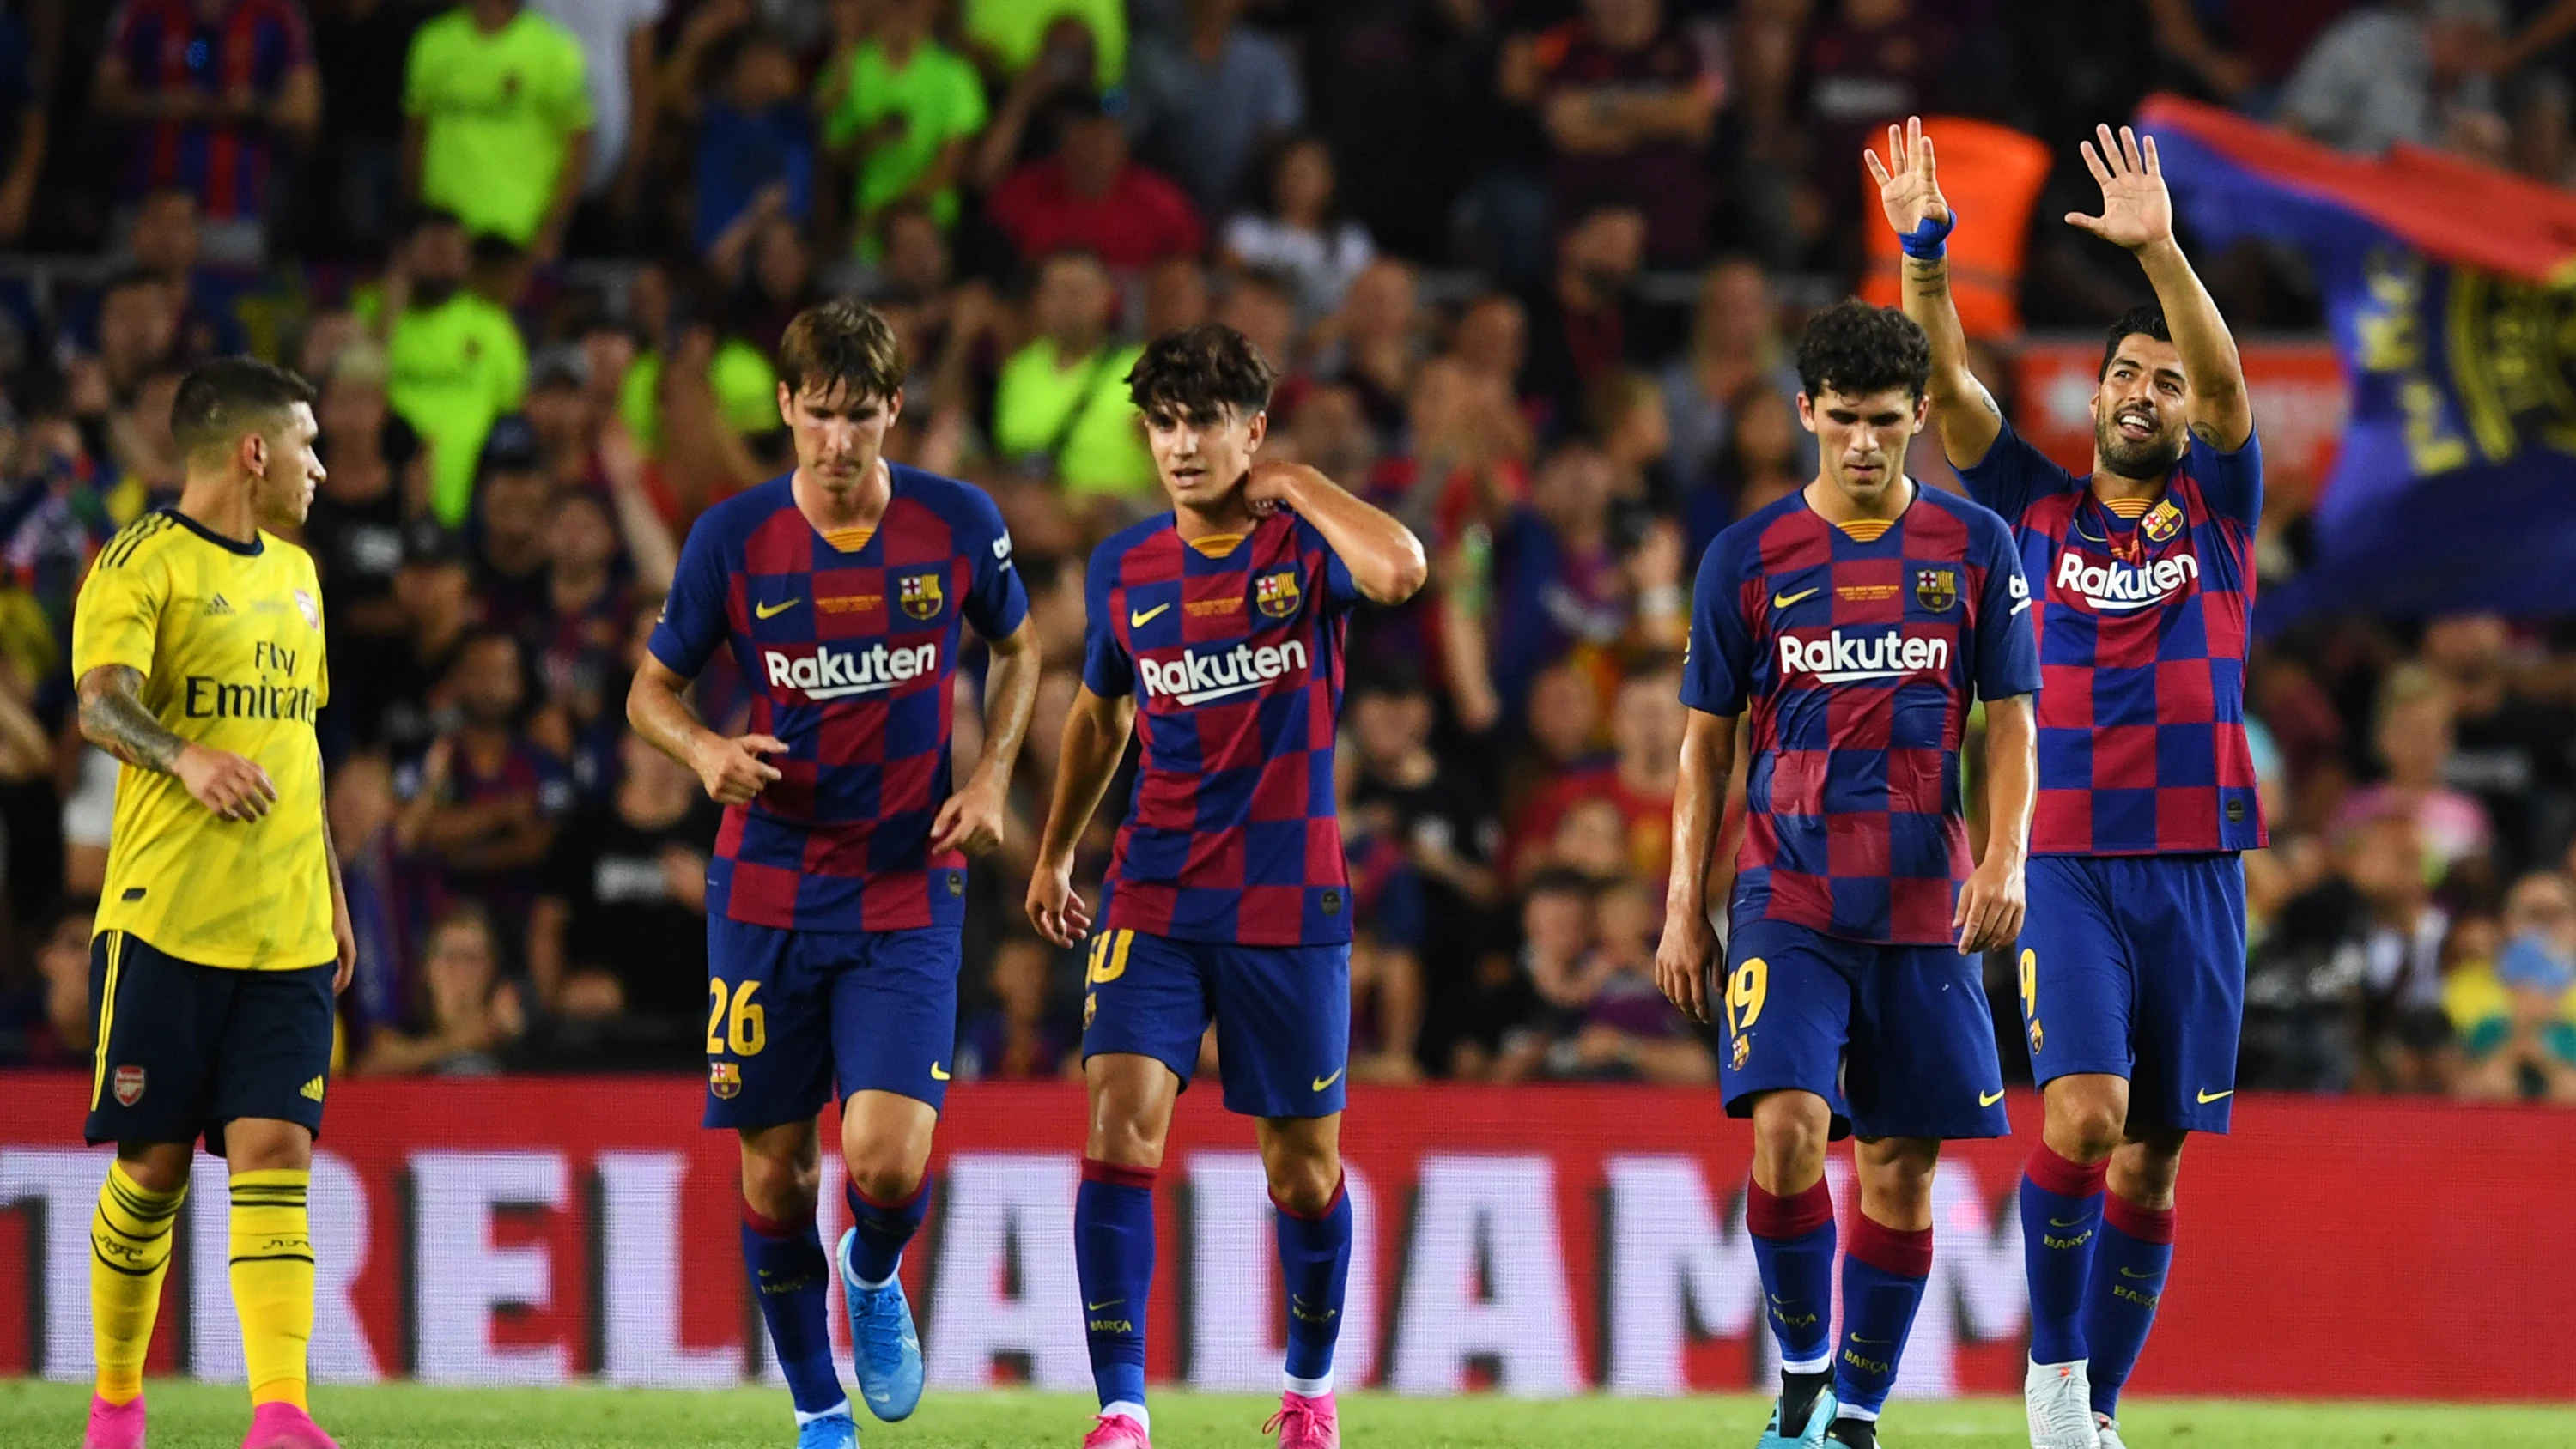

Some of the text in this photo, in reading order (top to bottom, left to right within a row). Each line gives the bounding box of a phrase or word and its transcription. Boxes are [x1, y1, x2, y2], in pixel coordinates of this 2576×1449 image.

[2056, 552, 2199, 600] Rakuten
[255, 640, 295, 678] Fly
[764, 642, 936, 689] Rakuten
[1139, 639, 1307, 697] Rakuten
[1779, 630, 1947, 673] Rakuten
[1725, 956, 1769, 1040] 19
[2019, 947, 2036, 1020] 9
[706, 976, 767, 1057] 26
[1089, 1319, 1133, 1334] BARÇA
[1844, 1348, 1889, 1375] BARÇA
